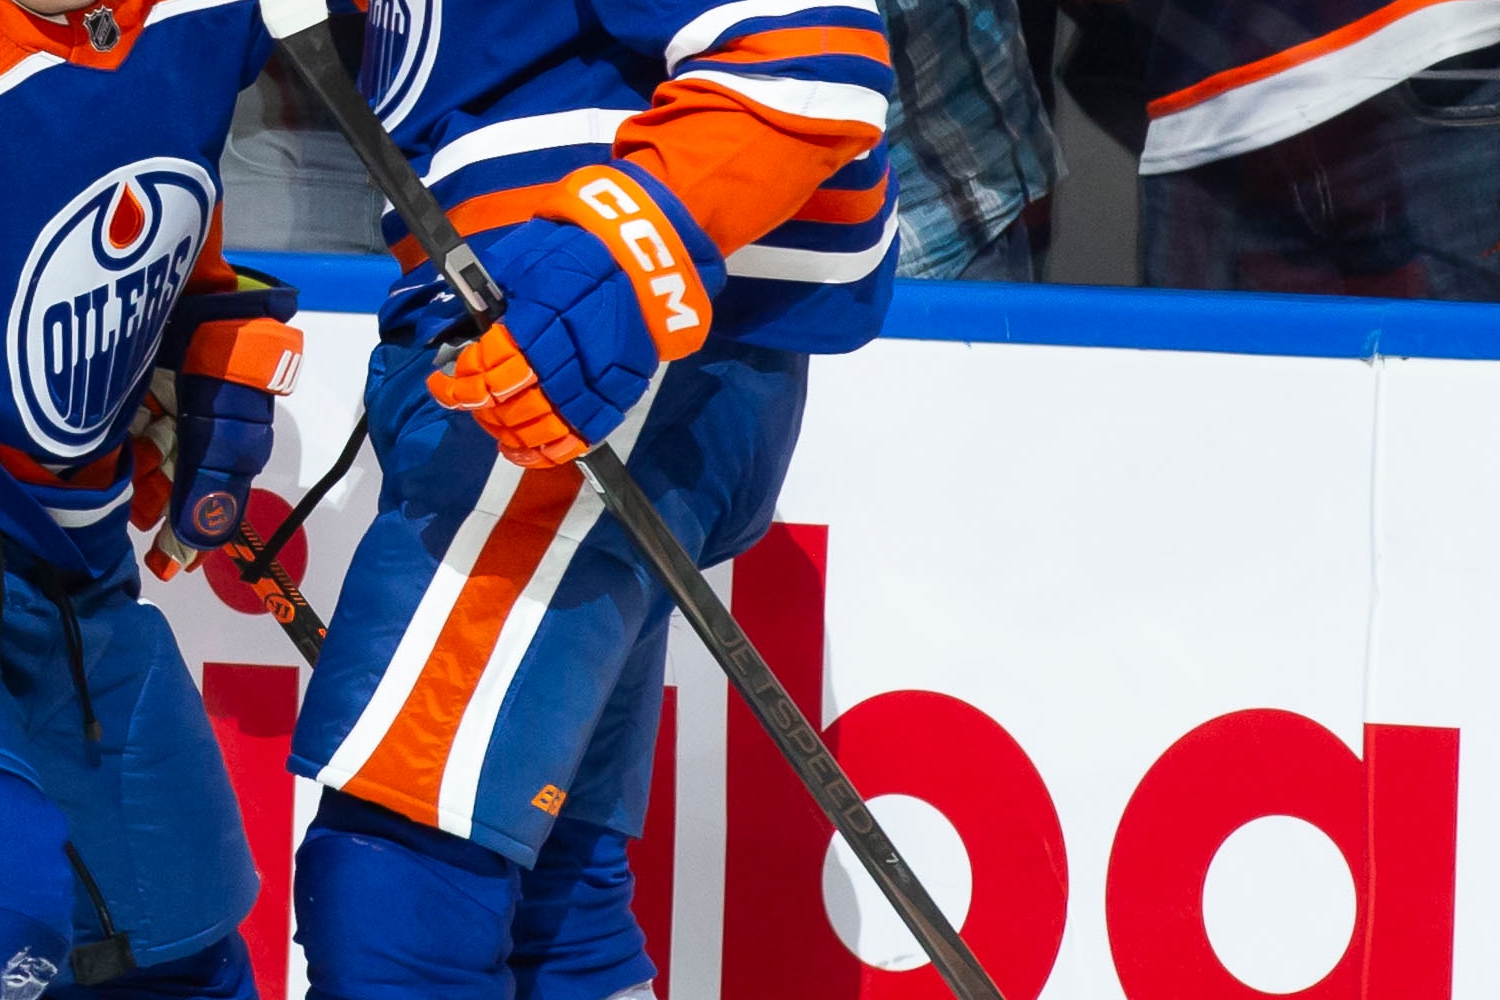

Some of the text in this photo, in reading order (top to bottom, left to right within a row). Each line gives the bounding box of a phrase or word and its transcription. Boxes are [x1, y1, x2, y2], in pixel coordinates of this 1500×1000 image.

[43, 235, 192, 385] OILERS
[577, 177, 701, 333] CCM
[712, 626, 875, 836] JETSPEED
